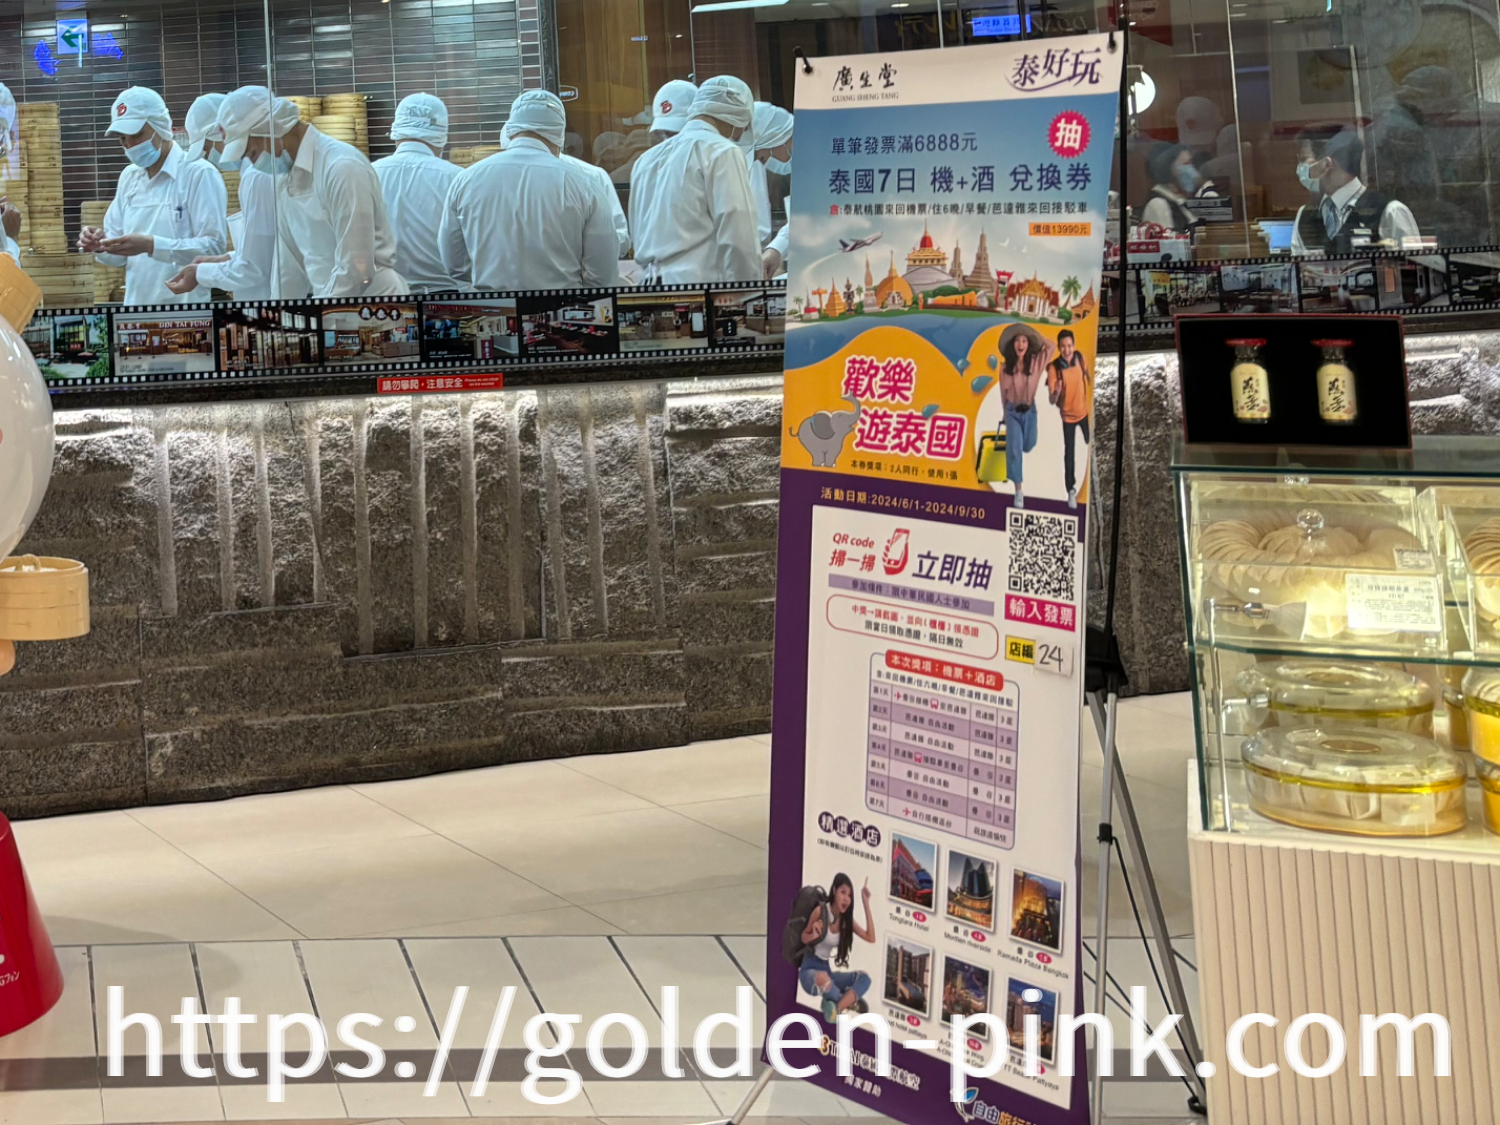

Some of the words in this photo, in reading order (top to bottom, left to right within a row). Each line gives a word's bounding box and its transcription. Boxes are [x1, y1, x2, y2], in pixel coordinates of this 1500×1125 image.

[832, 63, 898, 91] 廣生堂
[1011, 47, 1102, 88] 泰好玩
[831, 132, 978, 156] 單筆發票滿6888元
[1054, 119, 1083, 150] 抽
[829, 168, 916, 195] 泰國7日
[930, 165, 995, 194] 機+酒
[843, 356, 916, 403] 歡樂
[854, 407, 966, 459] 遊泰國
[832, 532, 849, 544] QR
[850, 536, 875, 549] code
[829, 548, 876, 572] 掃一掃
[912, 550, 993, 591] 立即抽
[1009, 597, 1074, 627] 輸入發票
[1037, 643, 1065, 673] 24
